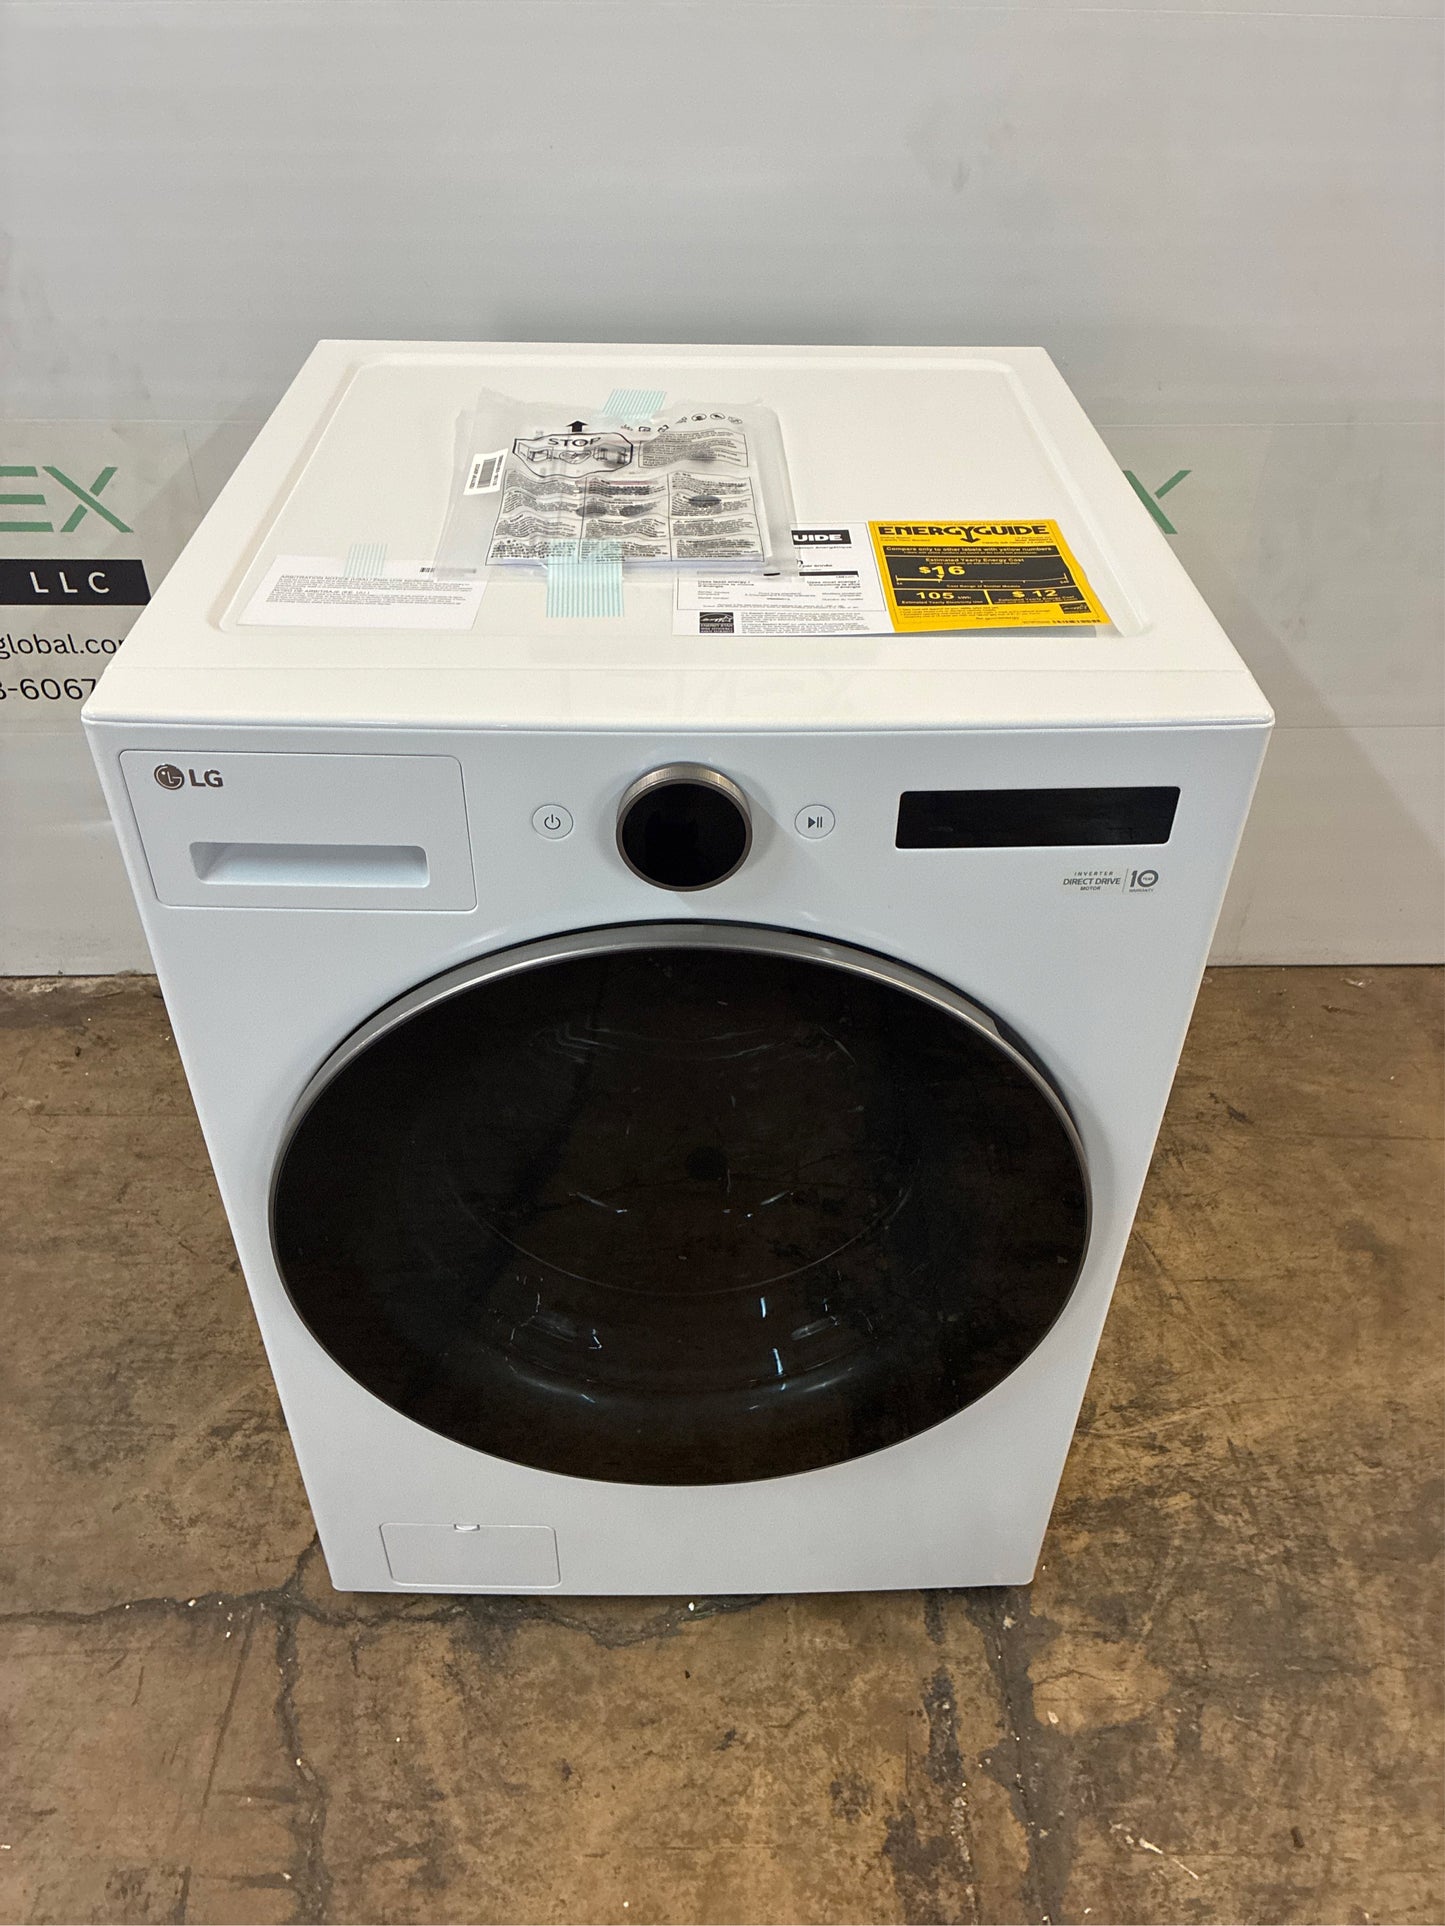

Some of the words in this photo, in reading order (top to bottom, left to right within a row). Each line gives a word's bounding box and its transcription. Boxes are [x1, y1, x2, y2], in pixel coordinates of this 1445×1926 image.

[548, 437, 601, 447] STOP
[878, 525, 1049, 541] ENERGYGUIDE
[918, 566, 966, 576] $16
[29, 571, 110, 594] LLC
[916, 592, 954, 600] 105
[188, 769, 224, 788] LG
[1063, 878, 1094, 886] DIRECT
[1130, 870, 1159, 888] 10
